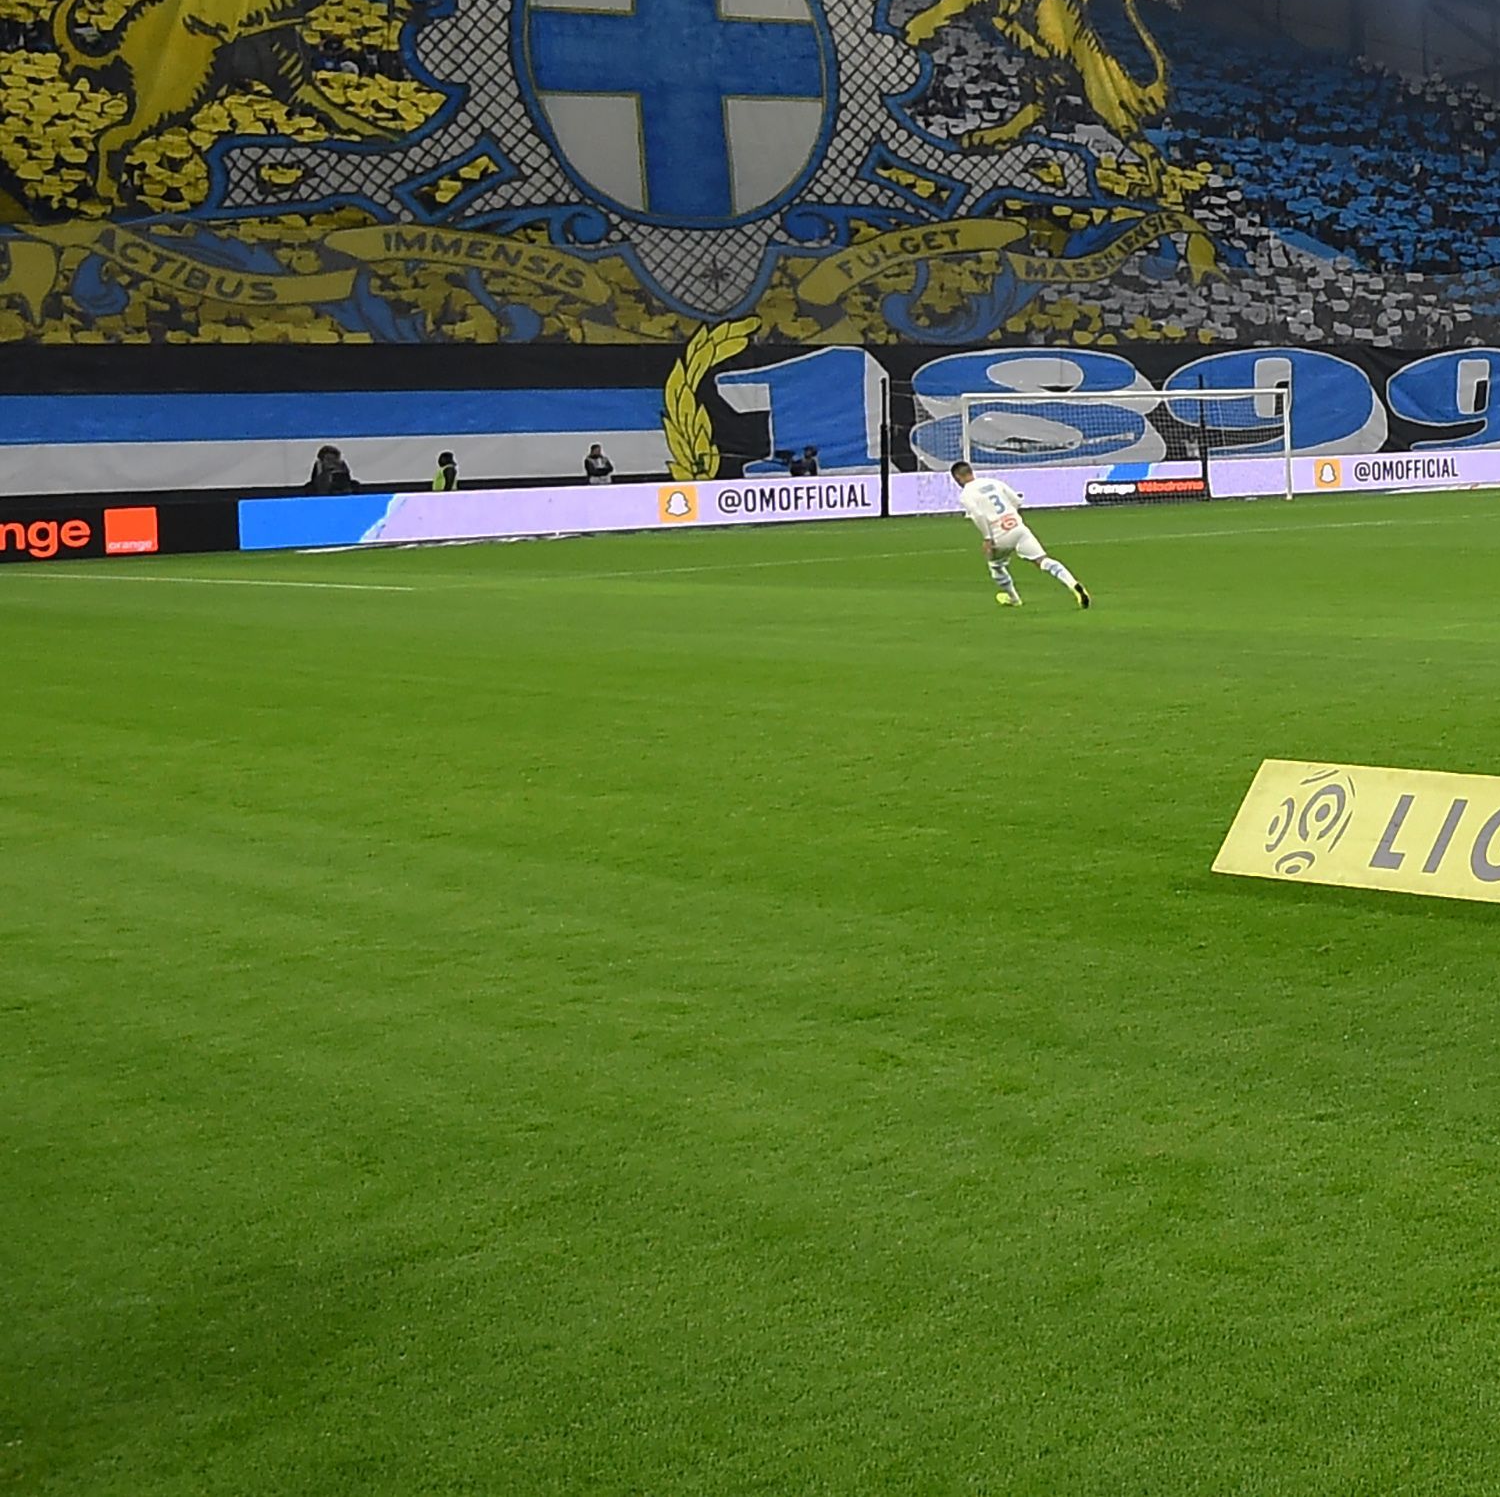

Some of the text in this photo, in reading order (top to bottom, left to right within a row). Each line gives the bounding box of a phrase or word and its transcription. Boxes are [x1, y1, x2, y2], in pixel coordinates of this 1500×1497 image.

[383, 231, 586, 290] IMMENSIS
[837, 227, 963, 280] FULGET
[118, 241, 277, 302] CTIBUS
[1354, 457, 1459, 482] @OMOFFICIAL
[717, 483, 872, 514] @OMOFFICIAL
[988, 494, 1006, 515] 3
[0, 519, 91, 558] nge
[109, 540, 153, 552] orange
